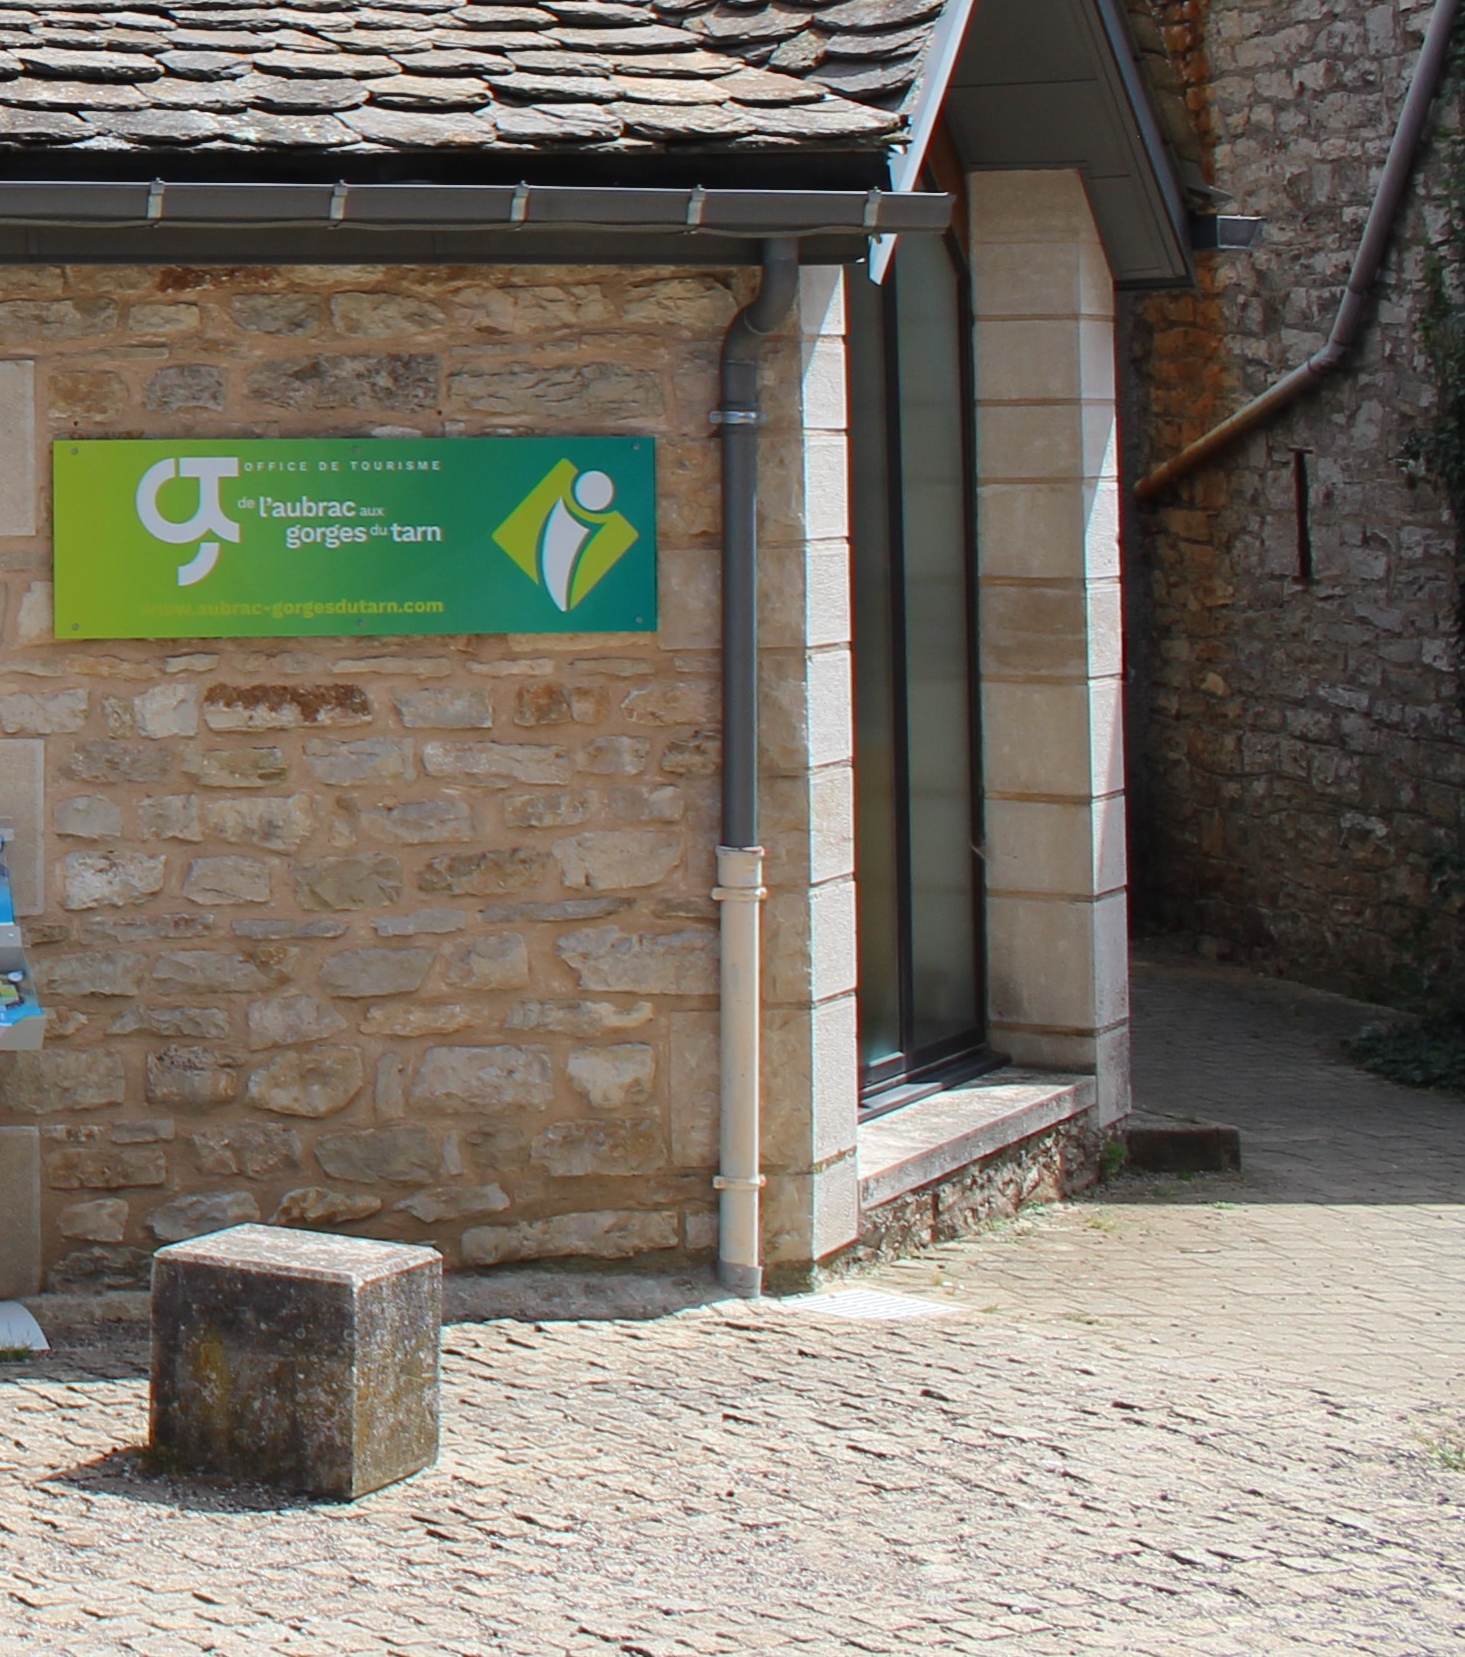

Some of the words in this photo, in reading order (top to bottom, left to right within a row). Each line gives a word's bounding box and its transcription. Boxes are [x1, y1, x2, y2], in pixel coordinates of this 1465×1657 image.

[243, 461, 309, 472] OFFICE
[318, 460, 340, 472] DE
[349, 460, 441, 472] TOURISME
[237, 495, 256, 510] de
[258, 495, 357, 518] l'aubrac
[359, 505, 385, 518] aux
[285, 523, 369, 549] gorges
[369, 523, 389, 536] du
[389, 522, 444, 543] tarn
[140, 599, 446, 621] www.aubrac-gorgesdutarn.com
